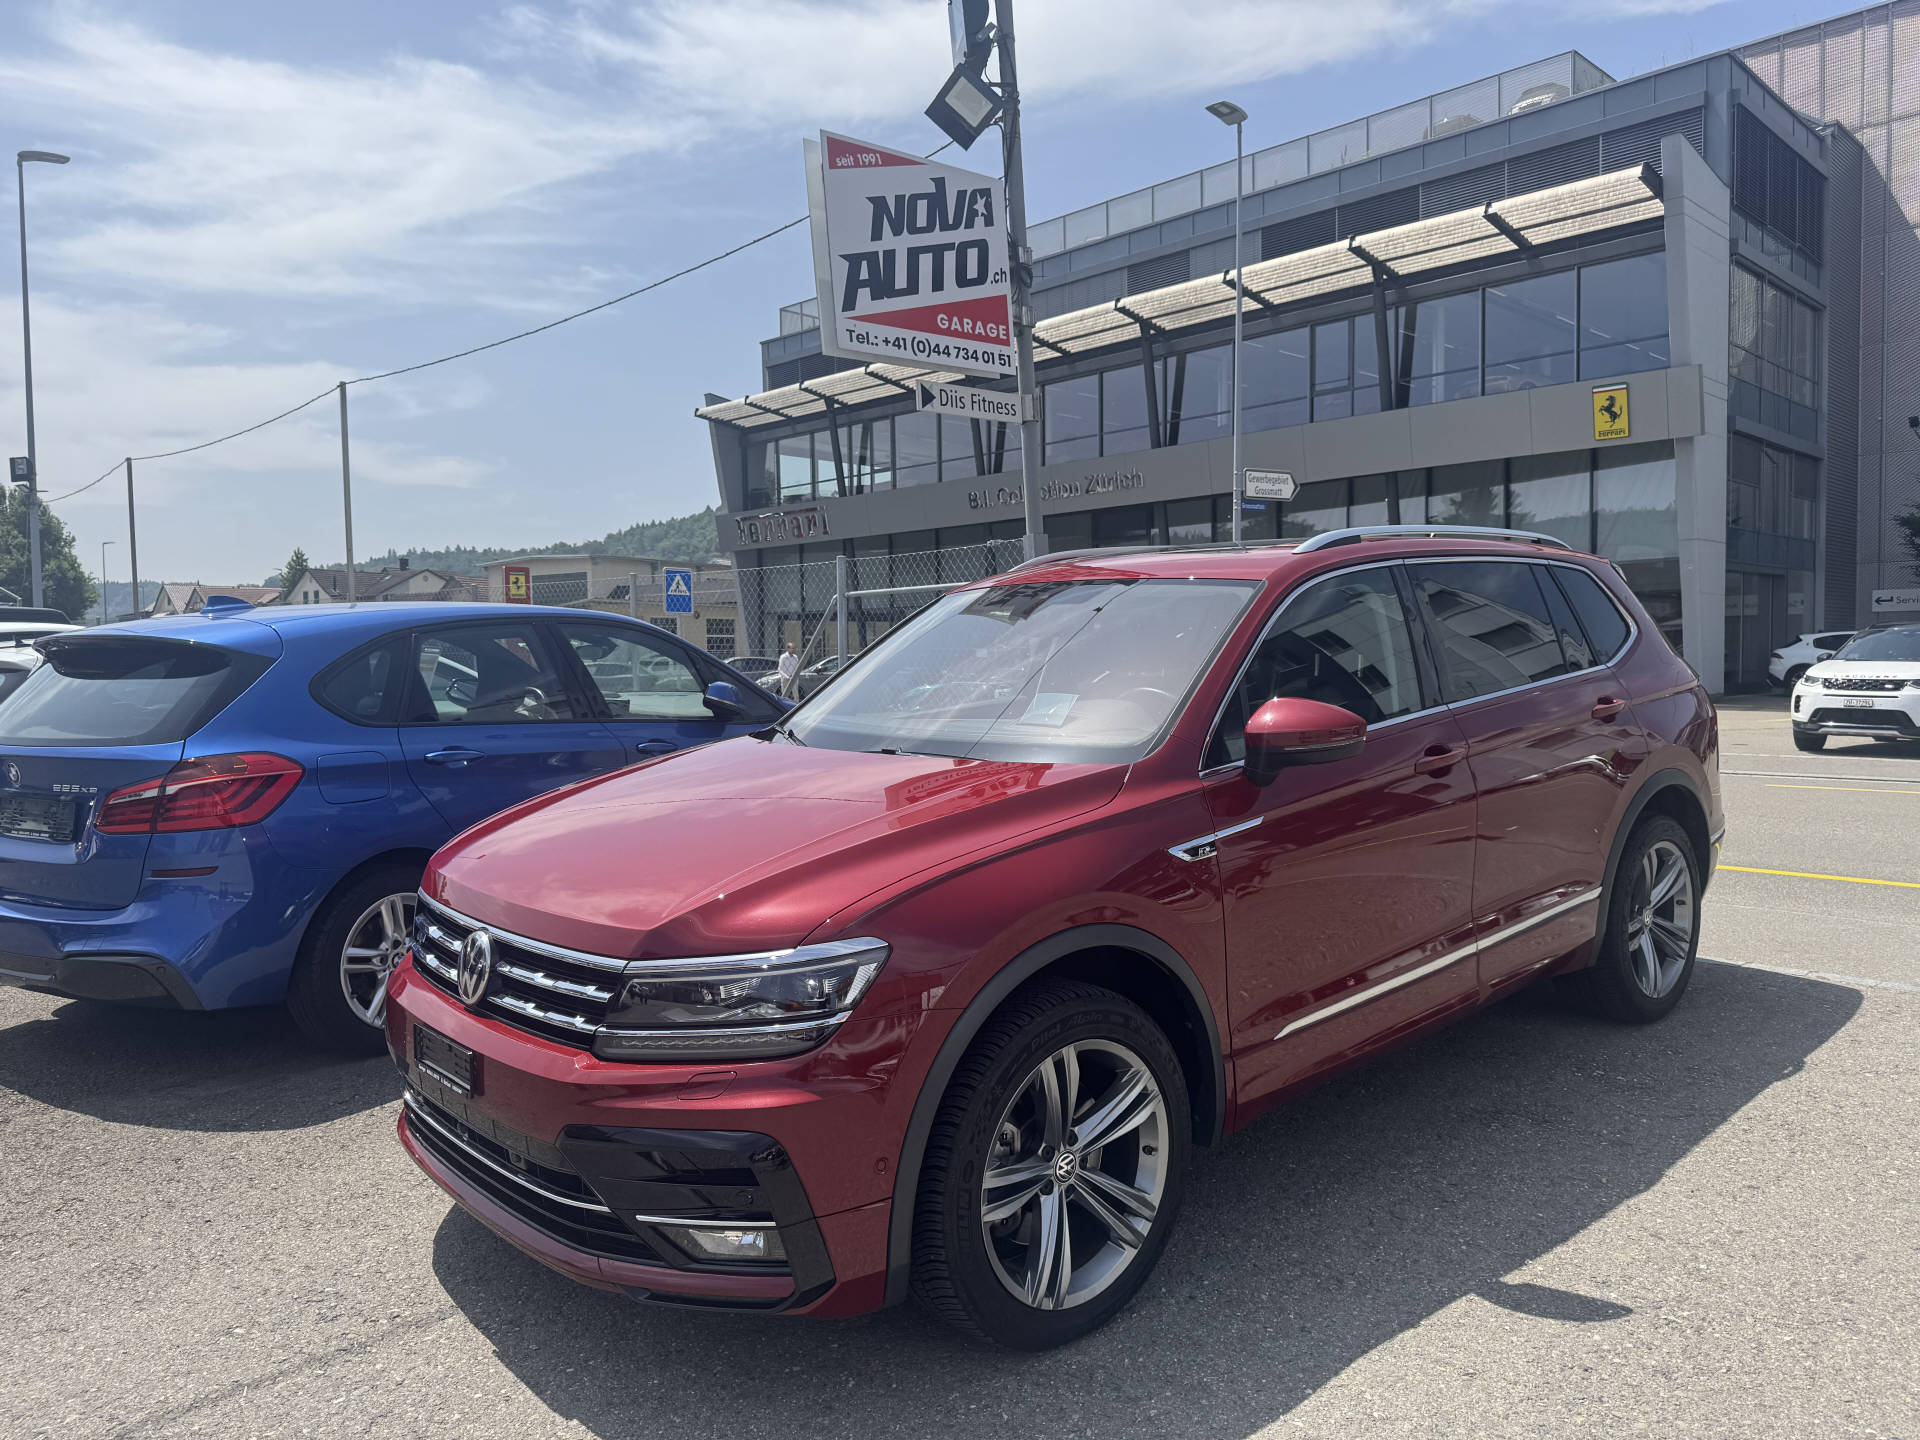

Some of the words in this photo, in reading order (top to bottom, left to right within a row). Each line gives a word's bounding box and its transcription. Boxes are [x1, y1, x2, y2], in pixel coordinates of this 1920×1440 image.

[836, 154, 855, 167] seit
[857, 153, 883, 166] 1991
[865, 177, 994, 241] NOVA
[937, 313, 1008, 340] GARAGE
[846, 328, 879, 347] Tel.:
[882, 336, 908, 351] +41
[953, 346, 979, 363] 734
[982, 350, 996, 365] 01
[998, 354, 1012, 368] 51
[940, 388, 966, 410] Diis
[970, 393, 1017, 417] Fitness
[1598, 428, 1626, 438] Ferrari
[1084, 466, 1145, 495] Zürich
[736, 505, 831, 545] Ferrari
